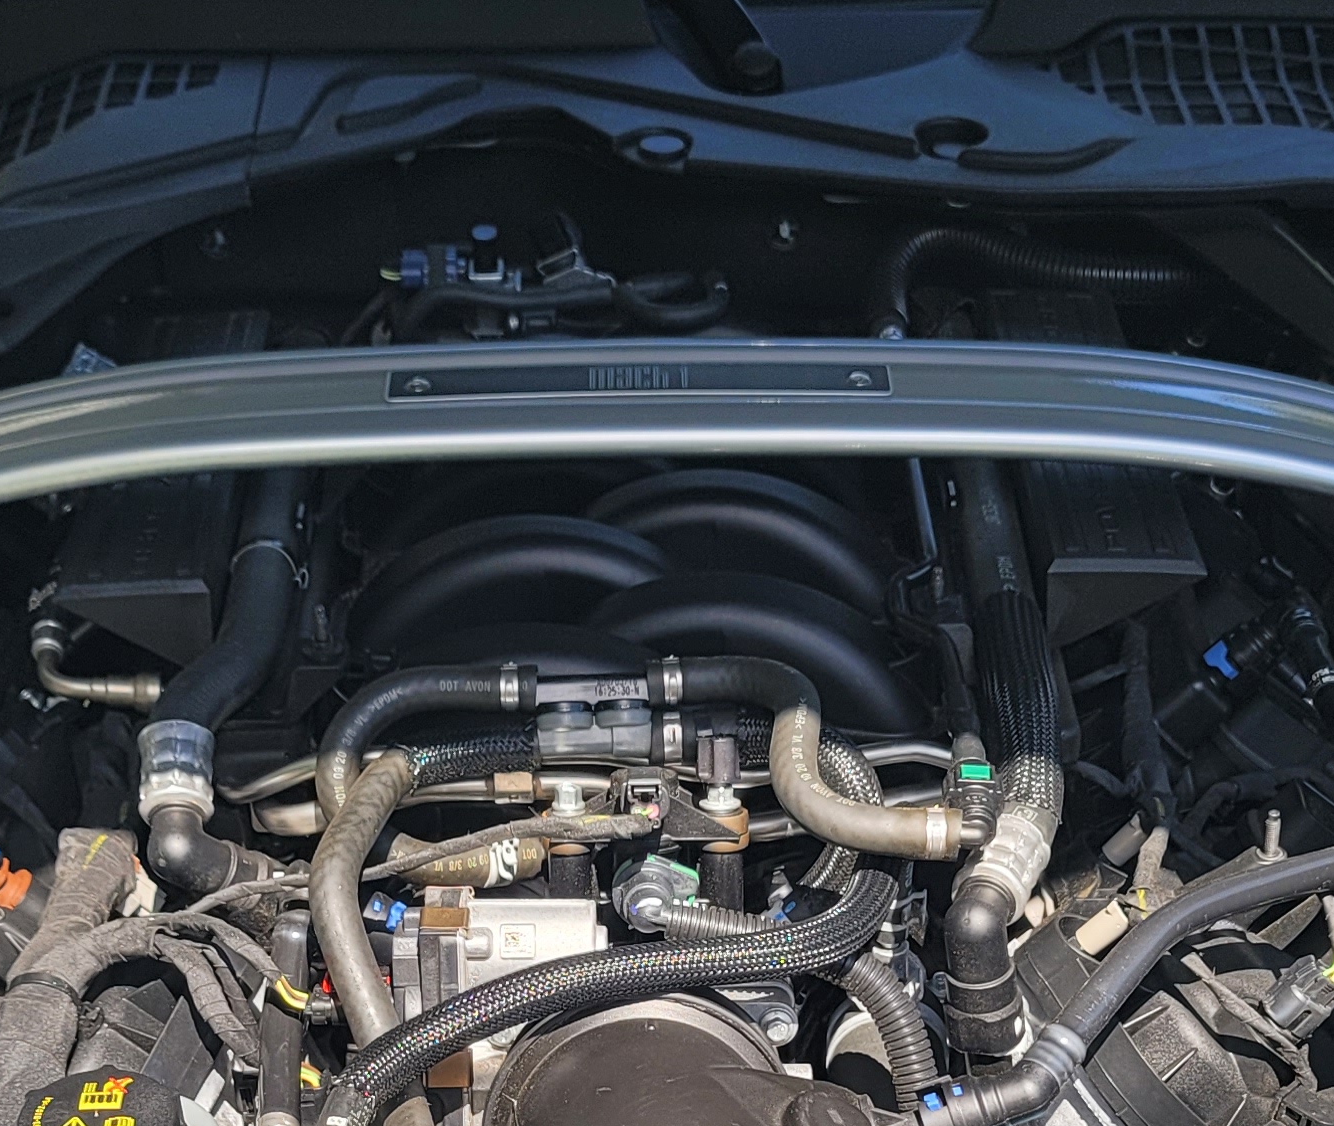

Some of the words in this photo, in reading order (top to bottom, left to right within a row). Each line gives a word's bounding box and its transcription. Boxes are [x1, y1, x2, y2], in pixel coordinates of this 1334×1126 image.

[439, 680, 459, 692] DOT
[465, 680, 491, 692] AVON
[335, 752, 347, 764] 20
[521, 848, 538, 860] DOT
[467, 857, 477, 869] 20
